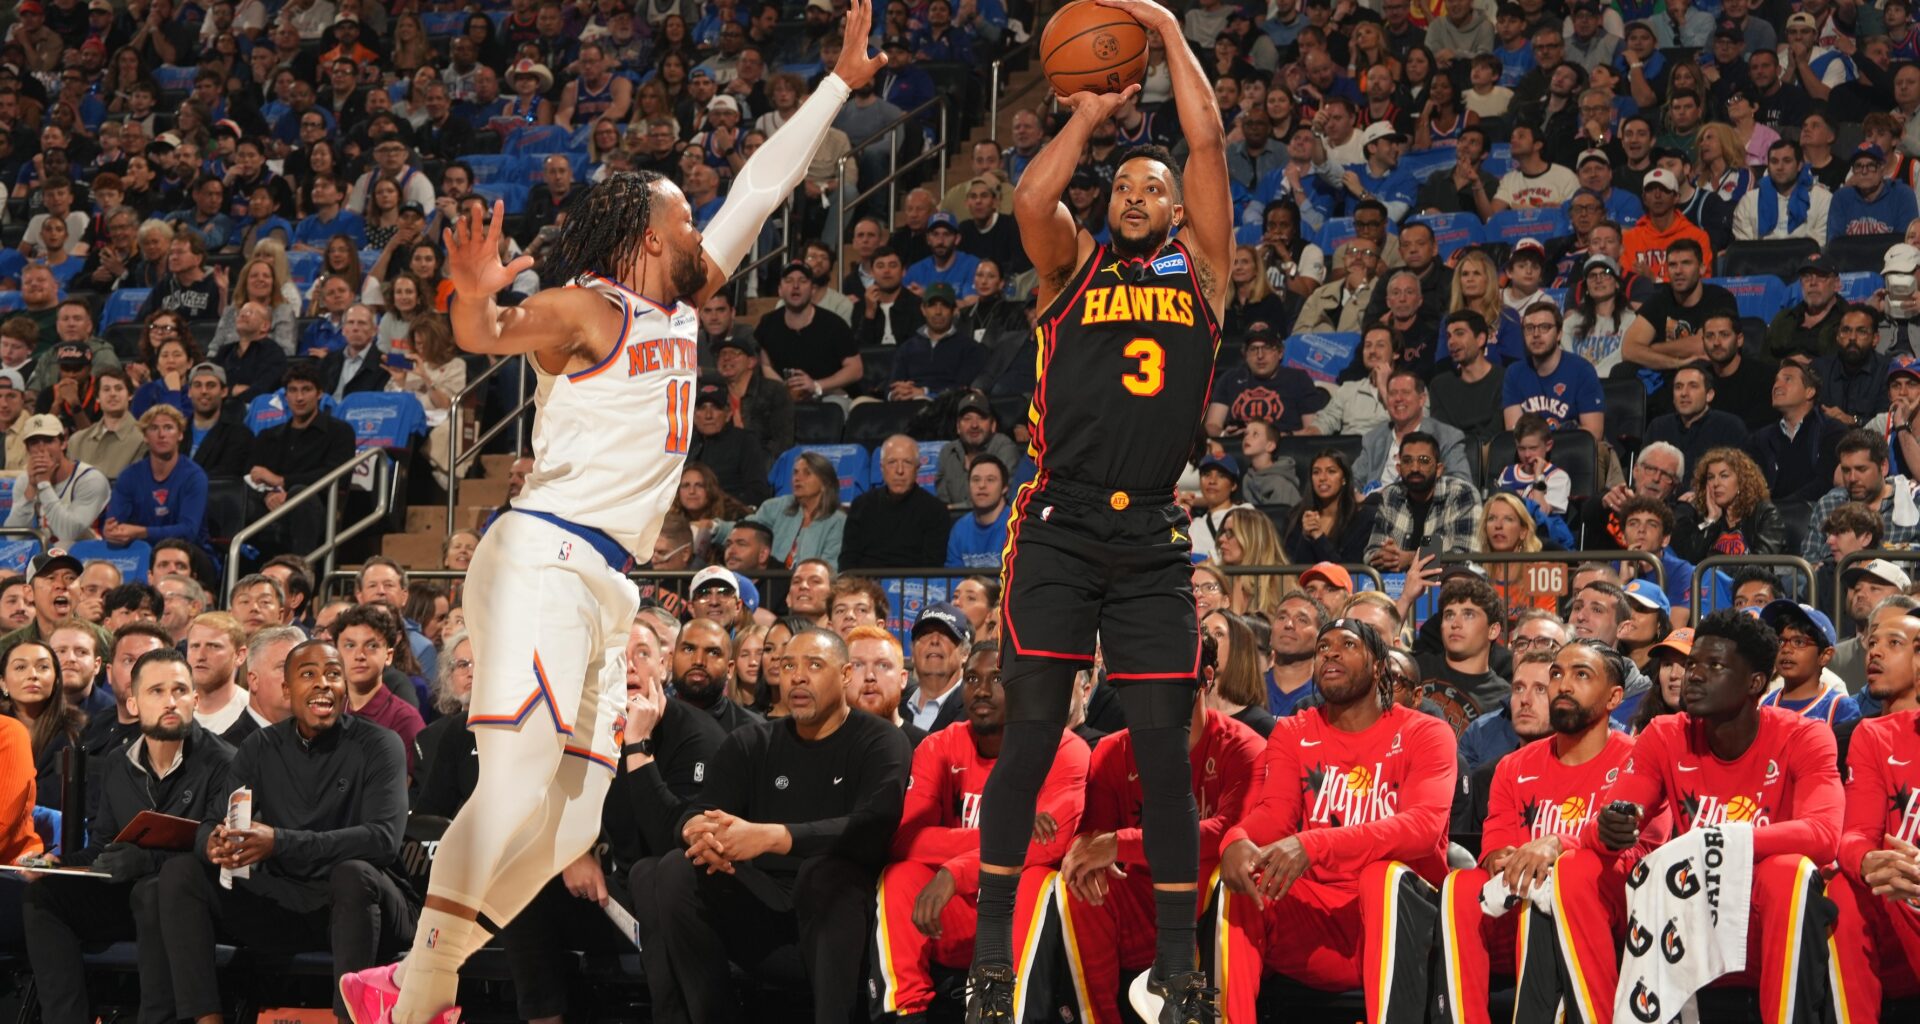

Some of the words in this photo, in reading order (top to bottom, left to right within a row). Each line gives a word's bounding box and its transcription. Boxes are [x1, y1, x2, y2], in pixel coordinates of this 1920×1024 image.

[1155, 257, 1184, 271] paze
[1081, 284, 1195, 328] HAWKS
[627, 338, 675, 377] NEW
[676, 337, 697, 370] YO
[1122, 337, 1166, 397] 3
[665, 379, 690, 455] 11
[1528, 567, 1562, 592] 106
[1309, 762, 1398, 828] Hawks
[1531, 792, 1598, 840] Hawk
[1665, 859, 1701, 900] G
[1703, 825, 1725, 929] ATOR
[1626, 913, 1654, 958] G
[1661, 919, 1685, 965] G
[1629, 980, 1661, 1024] G
